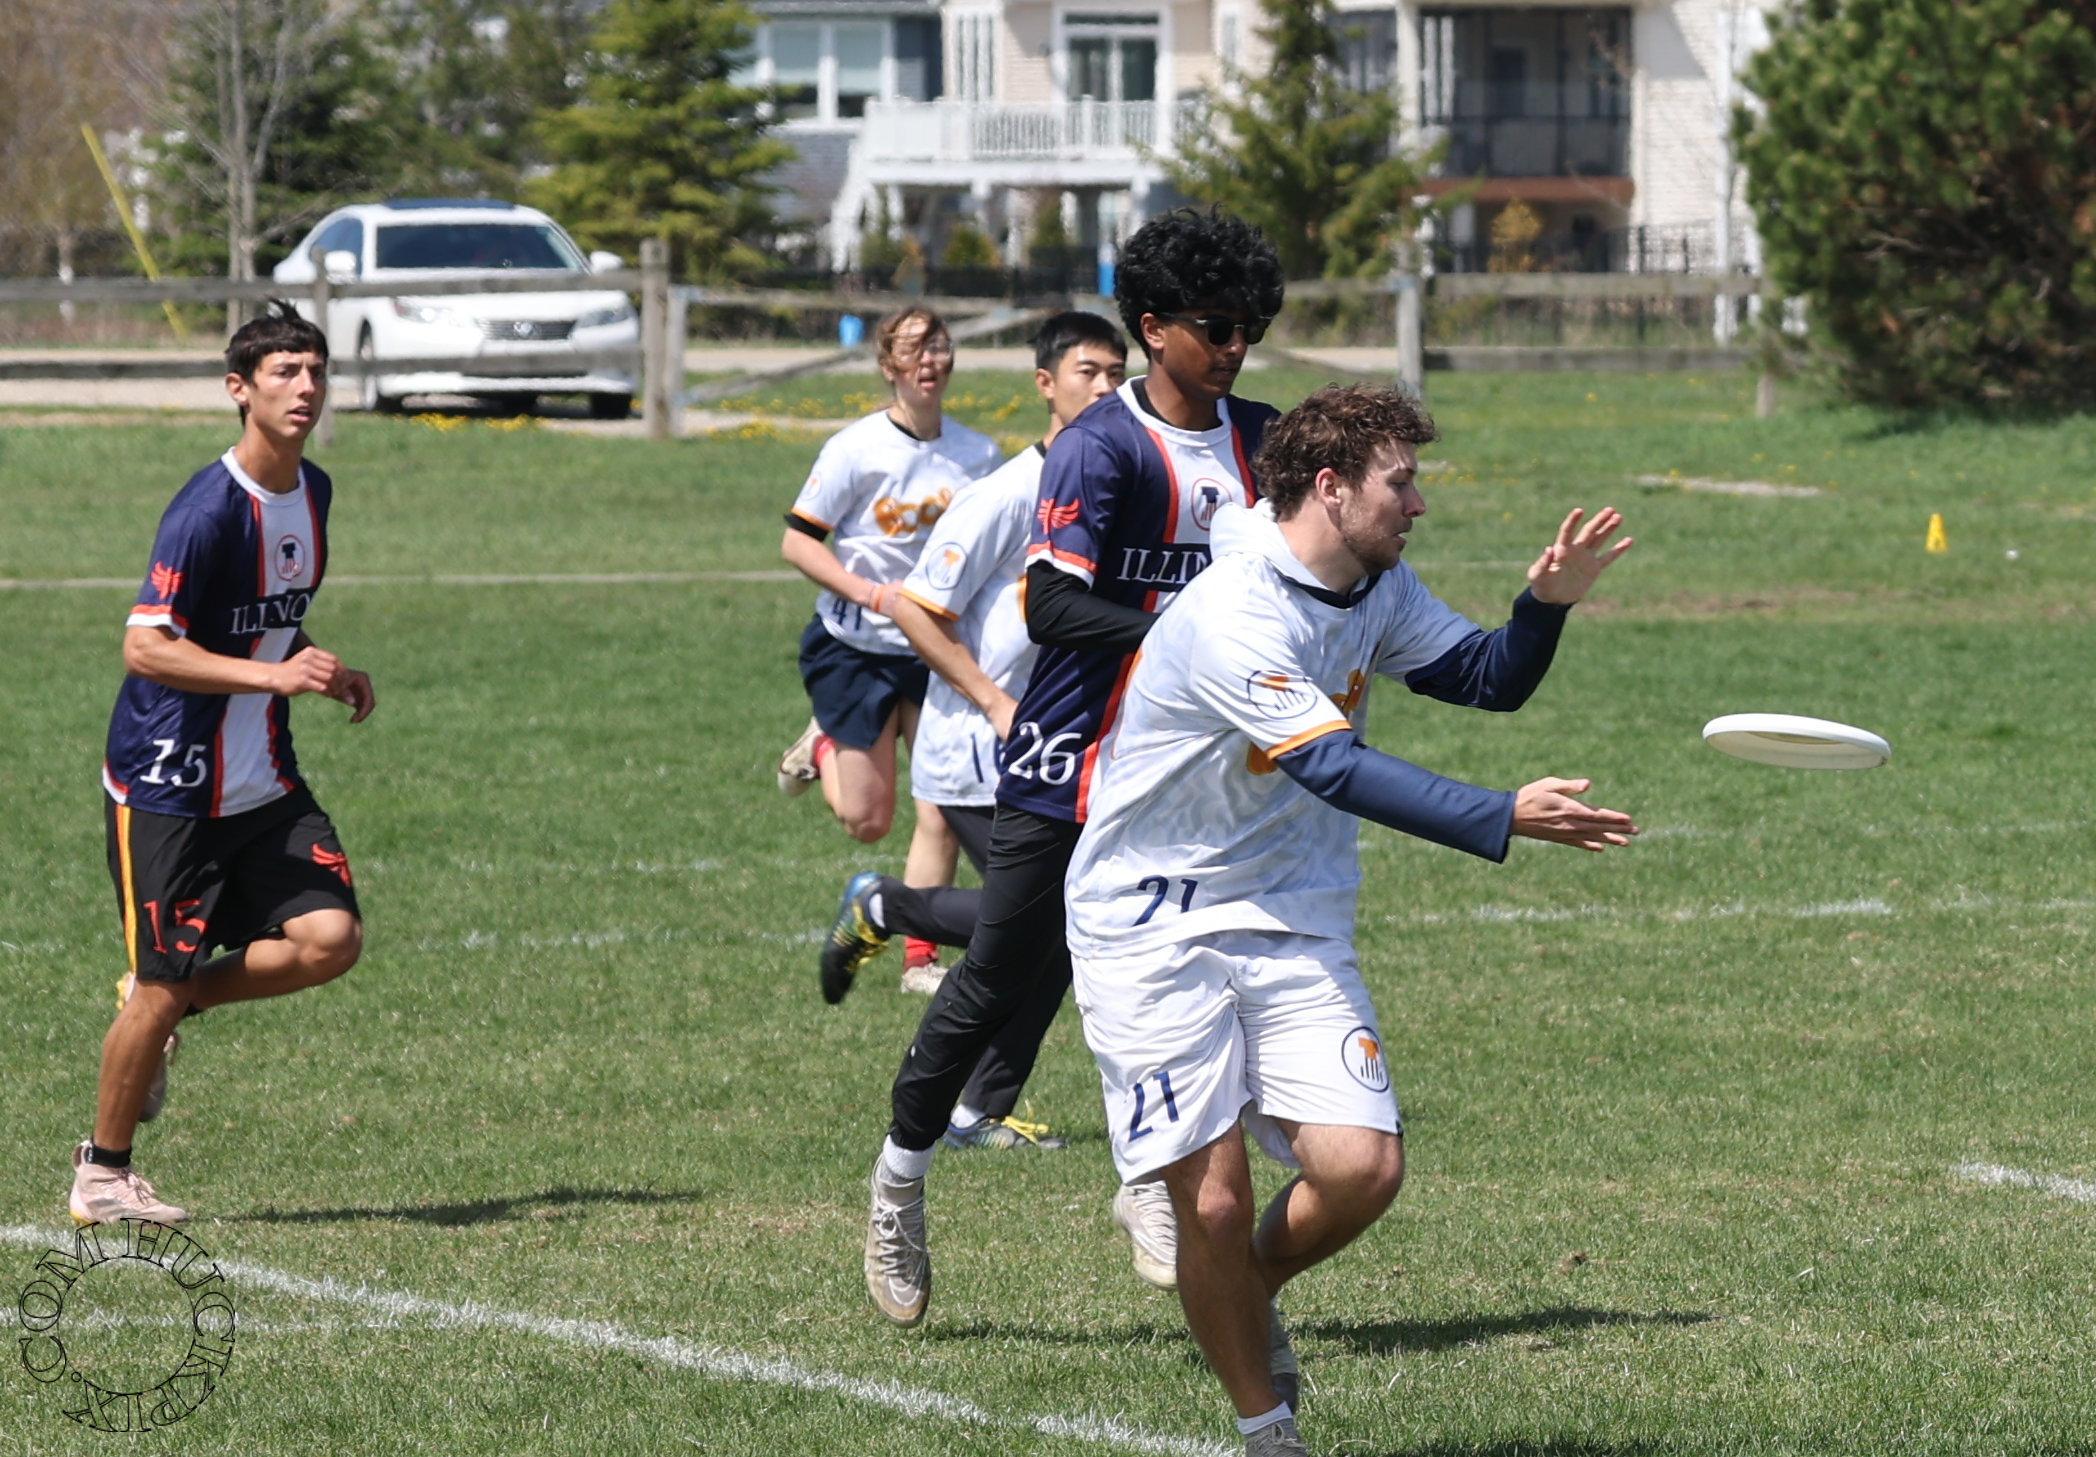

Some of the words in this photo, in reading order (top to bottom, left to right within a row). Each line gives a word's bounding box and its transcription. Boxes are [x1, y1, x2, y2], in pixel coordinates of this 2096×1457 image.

[1115, 546, 1212, 586] ILLIN
[139, 738, 208, 788] 15
[1007, 721, 1083, 786] 26
[143, 899, 208, 955] 15
[1131, 874, 1199, 927] 21
[1127, 1069, 1180, 1143] 21
